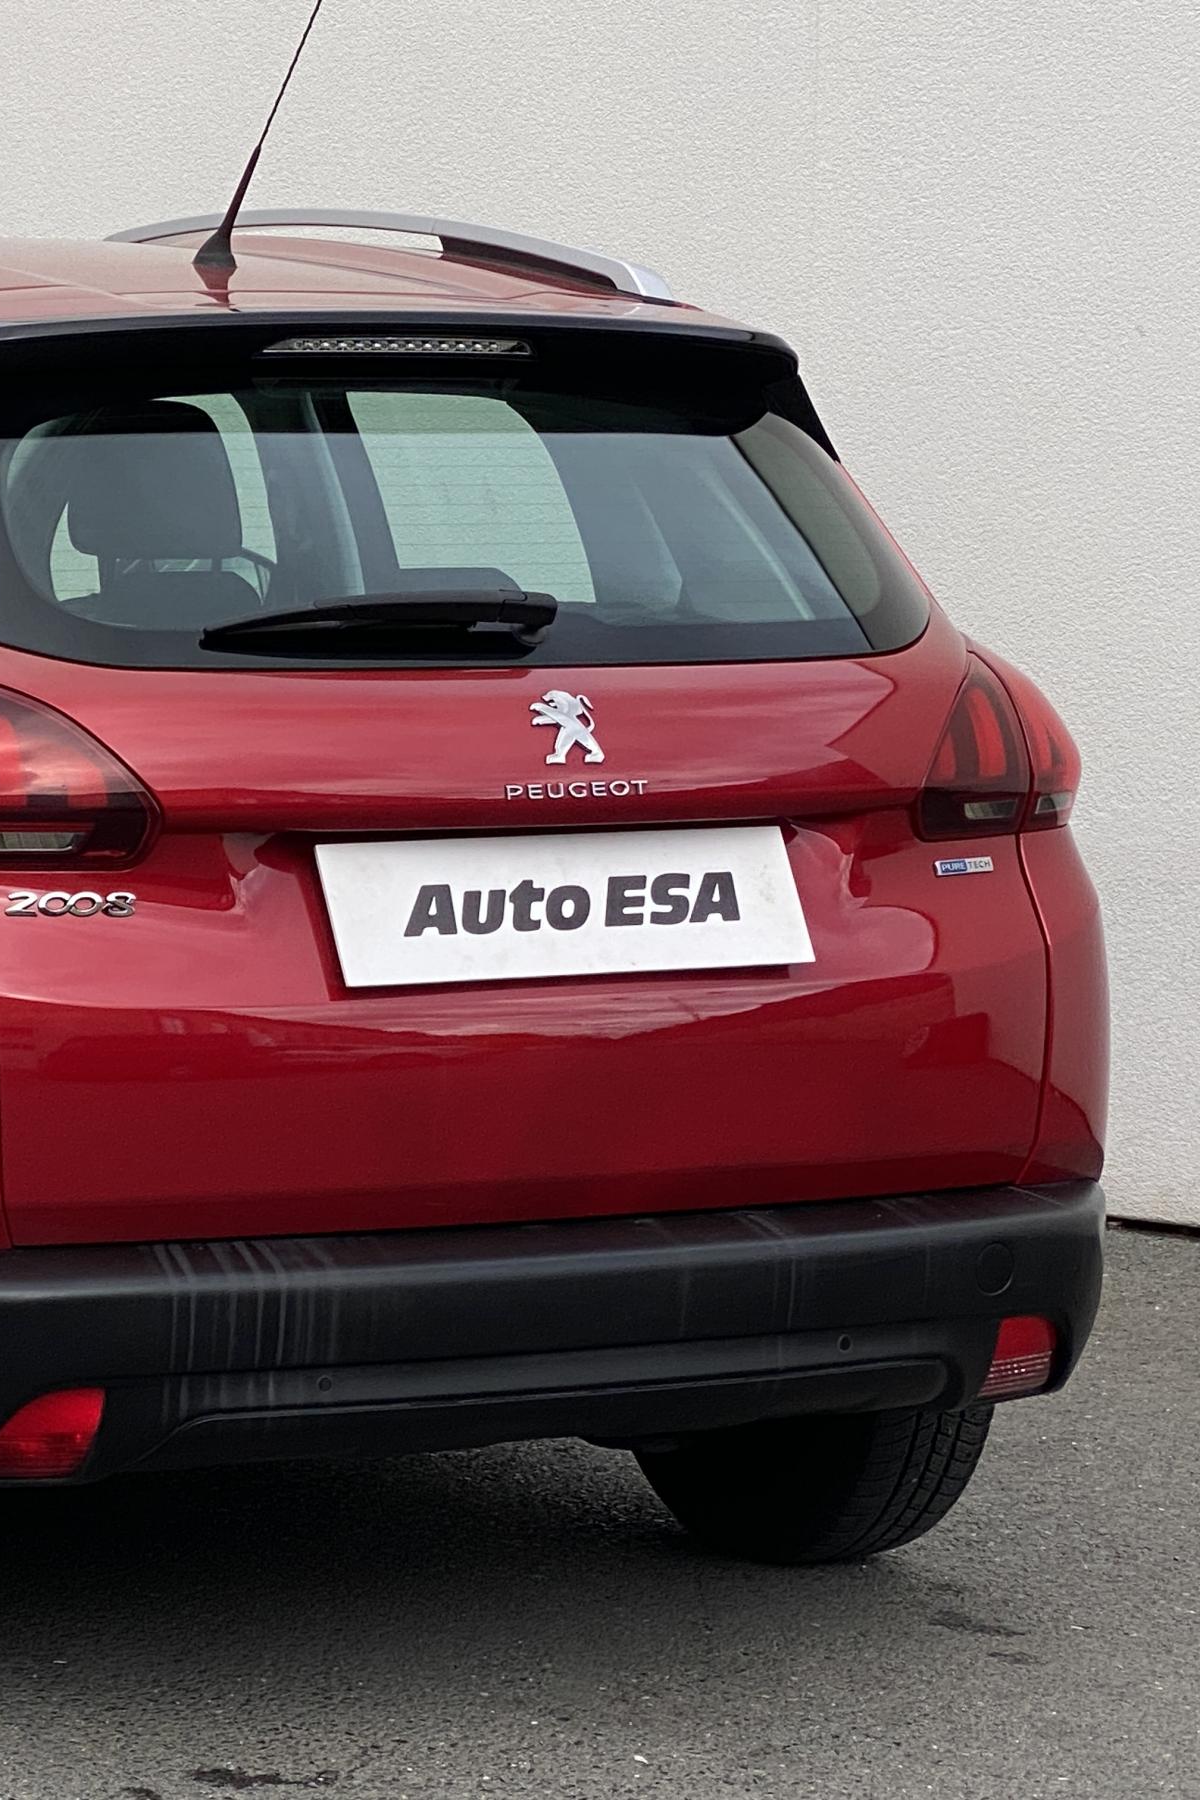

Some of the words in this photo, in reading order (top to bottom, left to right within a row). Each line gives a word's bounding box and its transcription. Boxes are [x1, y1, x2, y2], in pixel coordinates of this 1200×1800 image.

[505, 779, 648, 800] PEUGEOT
[4, 890, 137, 917] 2008
[403, 879, 591, 937] Auto
[604, 871, 741, 927] ESA
